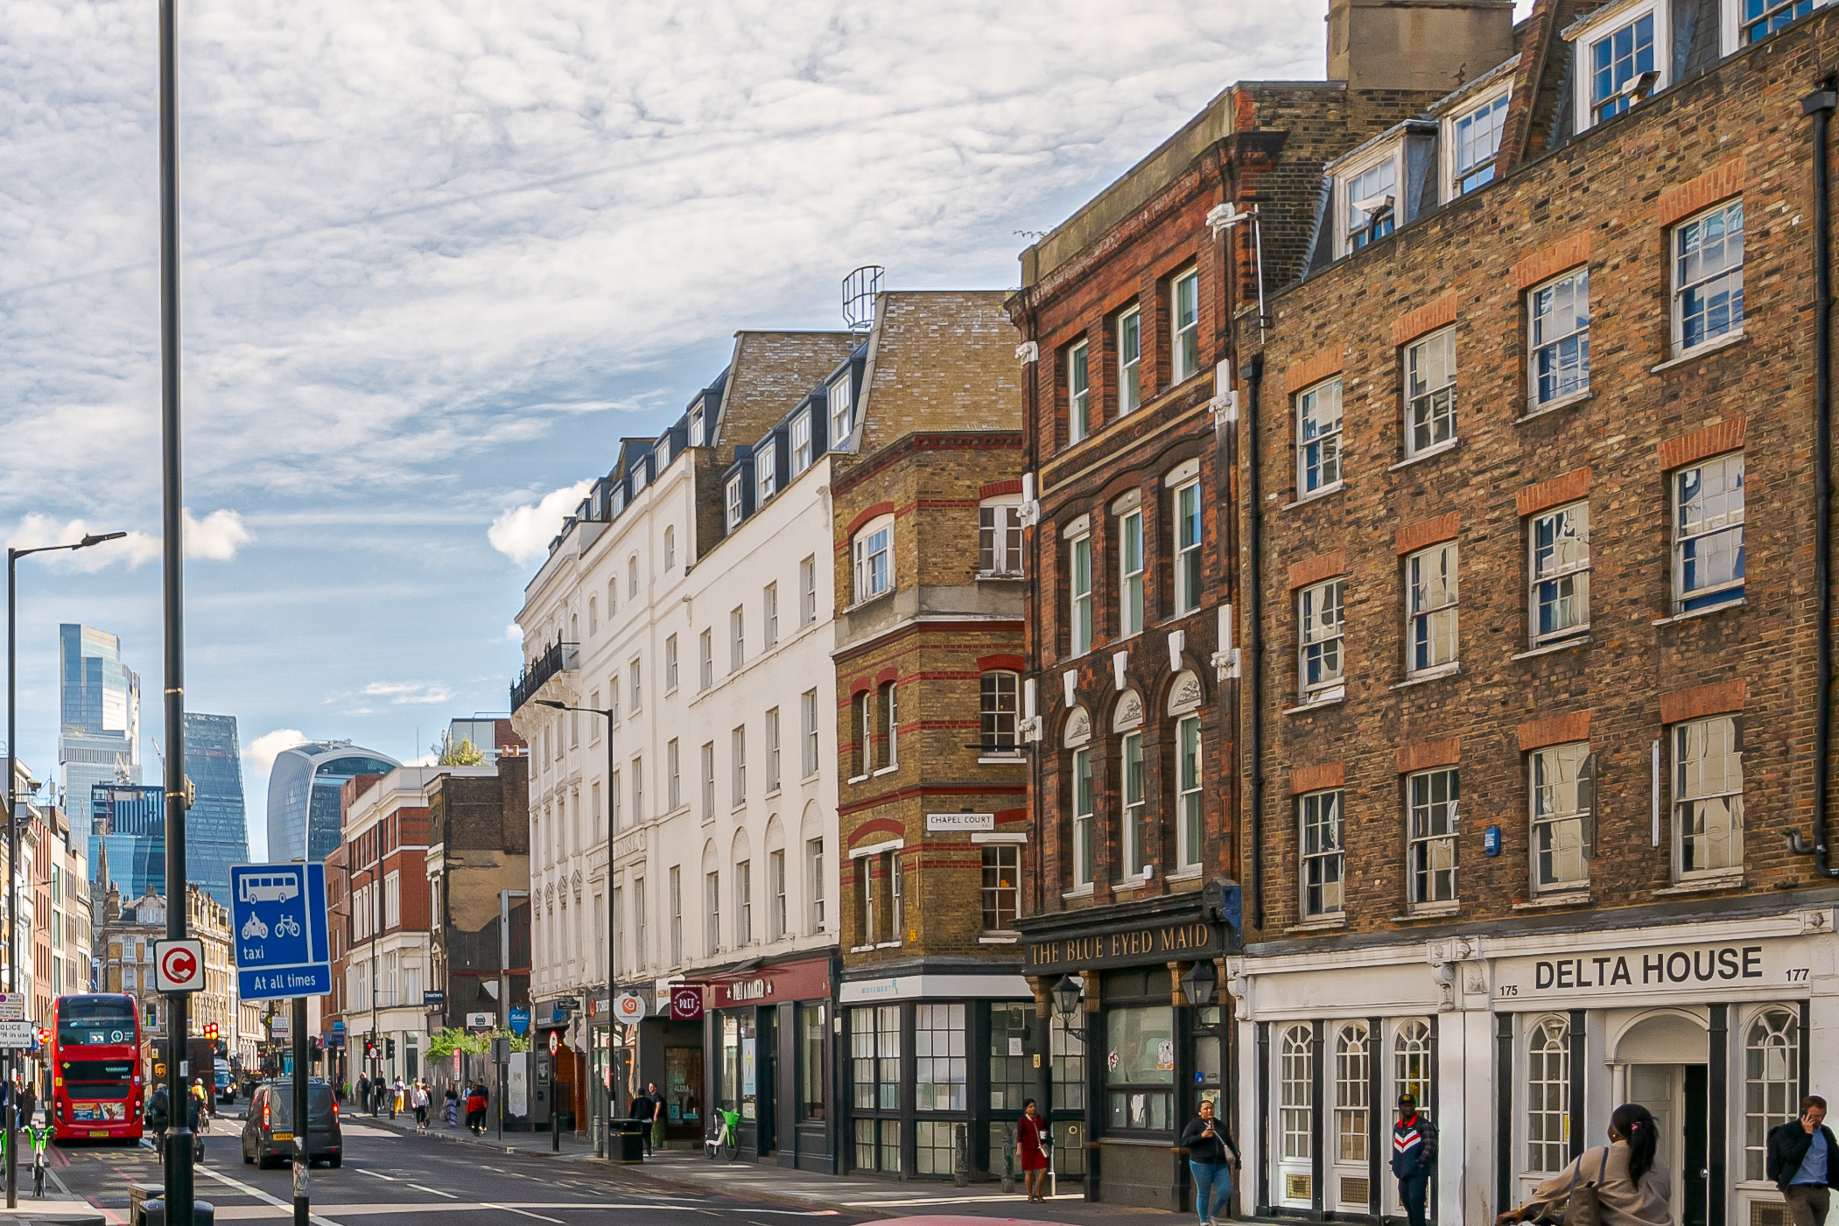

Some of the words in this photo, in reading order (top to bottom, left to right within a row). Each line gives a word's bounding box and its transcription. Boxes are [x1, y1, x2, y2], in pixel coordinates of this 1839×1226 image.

[930, 816, 962, 824] CHAPEL
[964, 815, 992, 824] COURT
[1030, 941, 1059, 965] THE
[1066, 936, 1104, 962] BLUE
[1111, 930, 1153, 957] EYED
[1161, 923, 1208, 951] MAID
[243, 944, 265, 960] taxi
[1535, 955, 1633, 990] DELTA
[1642, 945, 1763, 984] HOUSE
[1785, 968, 1810, 982] 177
[254, 975, 267, 991] At
[270, 974, 284, 989] all
[287, 972, 316, 988] times
[1499, 984, 1518, 997] 175
[679, 998, 695, 1009] PRET
